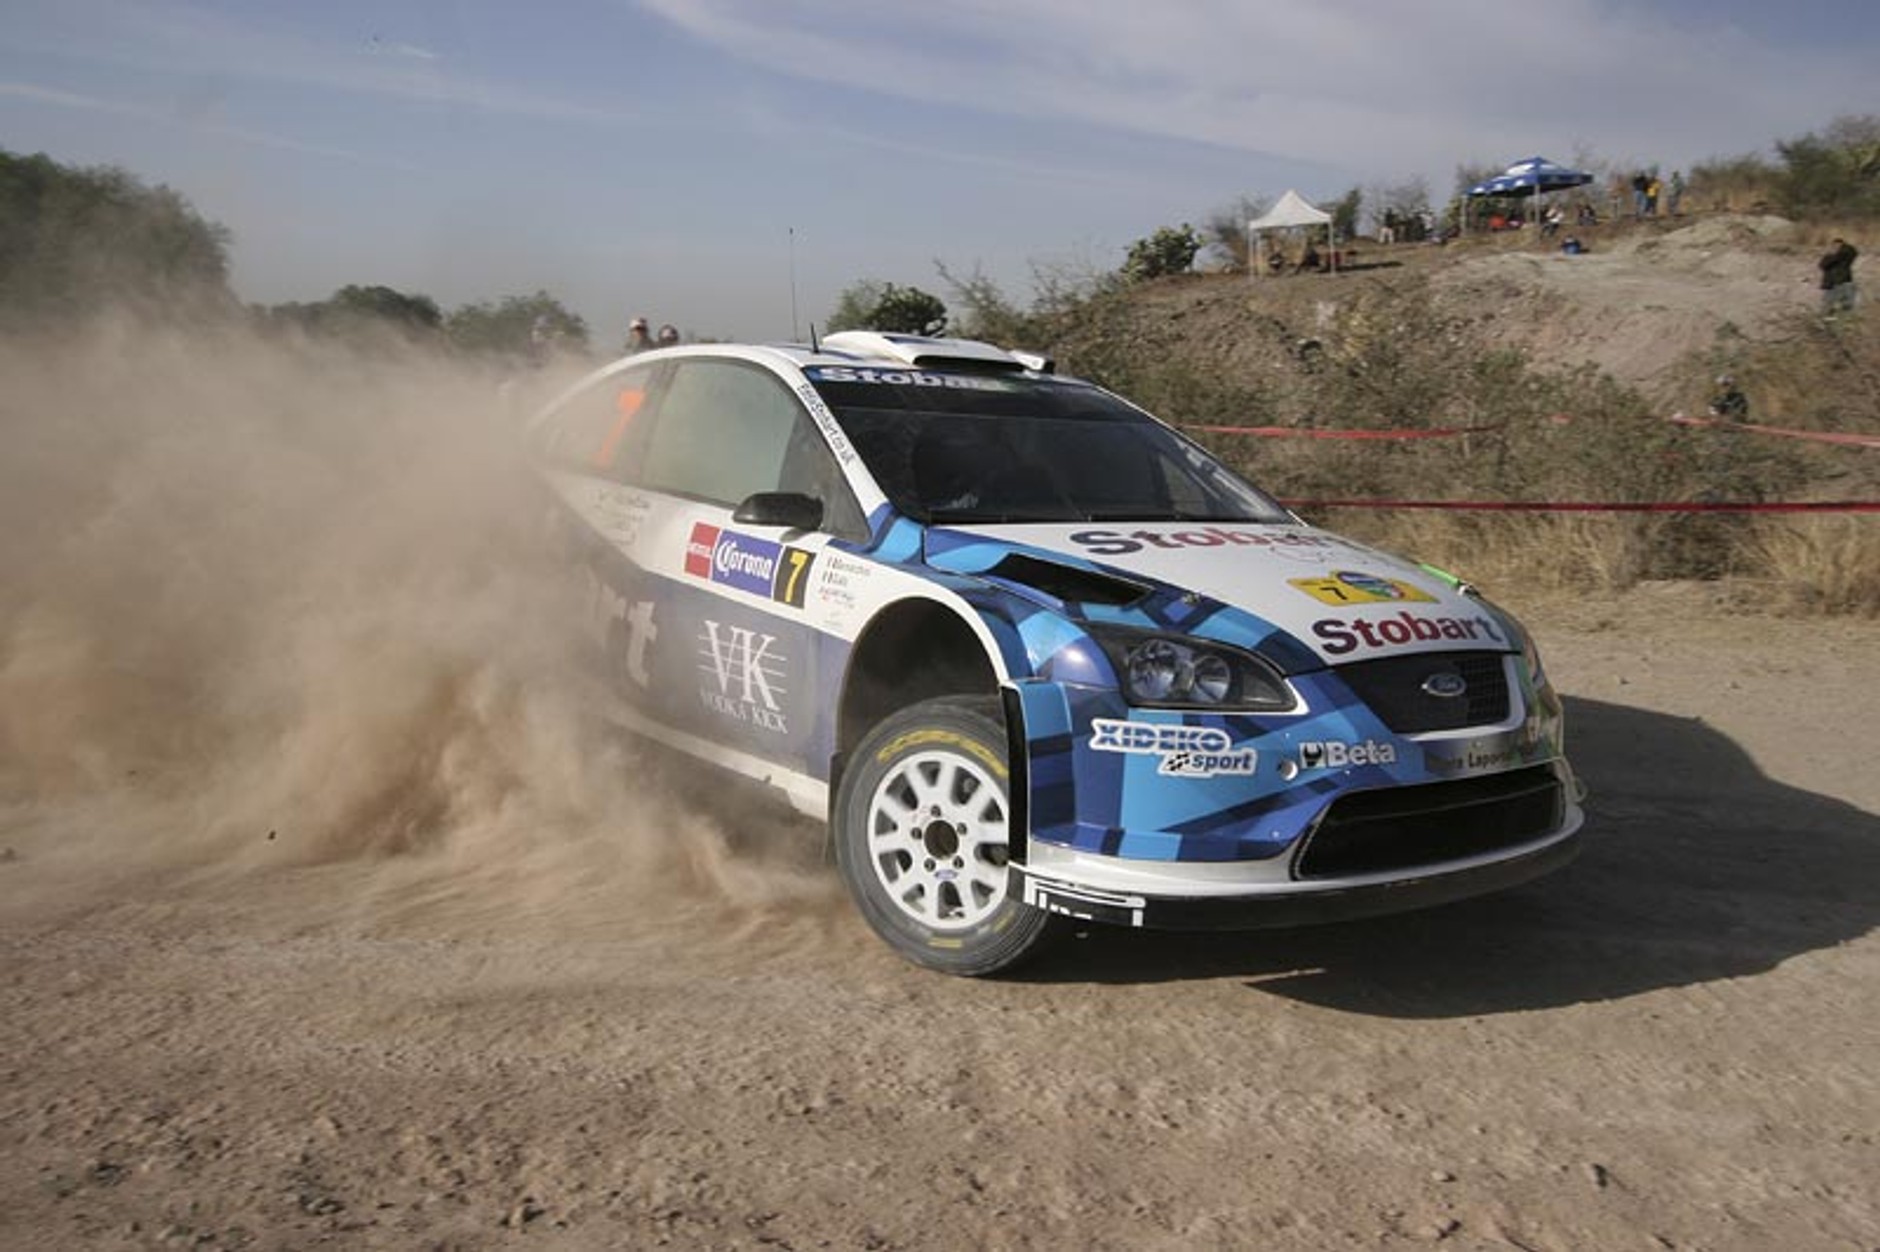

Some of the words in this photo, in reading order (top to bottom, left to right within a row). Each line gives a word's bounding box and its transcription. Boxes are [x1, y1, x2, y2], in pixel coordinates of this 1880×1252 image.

[594, 389, 646, 465] 7
[716, 540, 774, 581] Corona
[785, 551, 808, 603] 7
[1311, 611, 1505, 655] Stobart
[703, 619, 777, 712] VK
[1097, 722, 1230, 752] XIDEKO
[1326, 740, 1397, 767] Beta
[1191, 751, 1253, 774] sport
